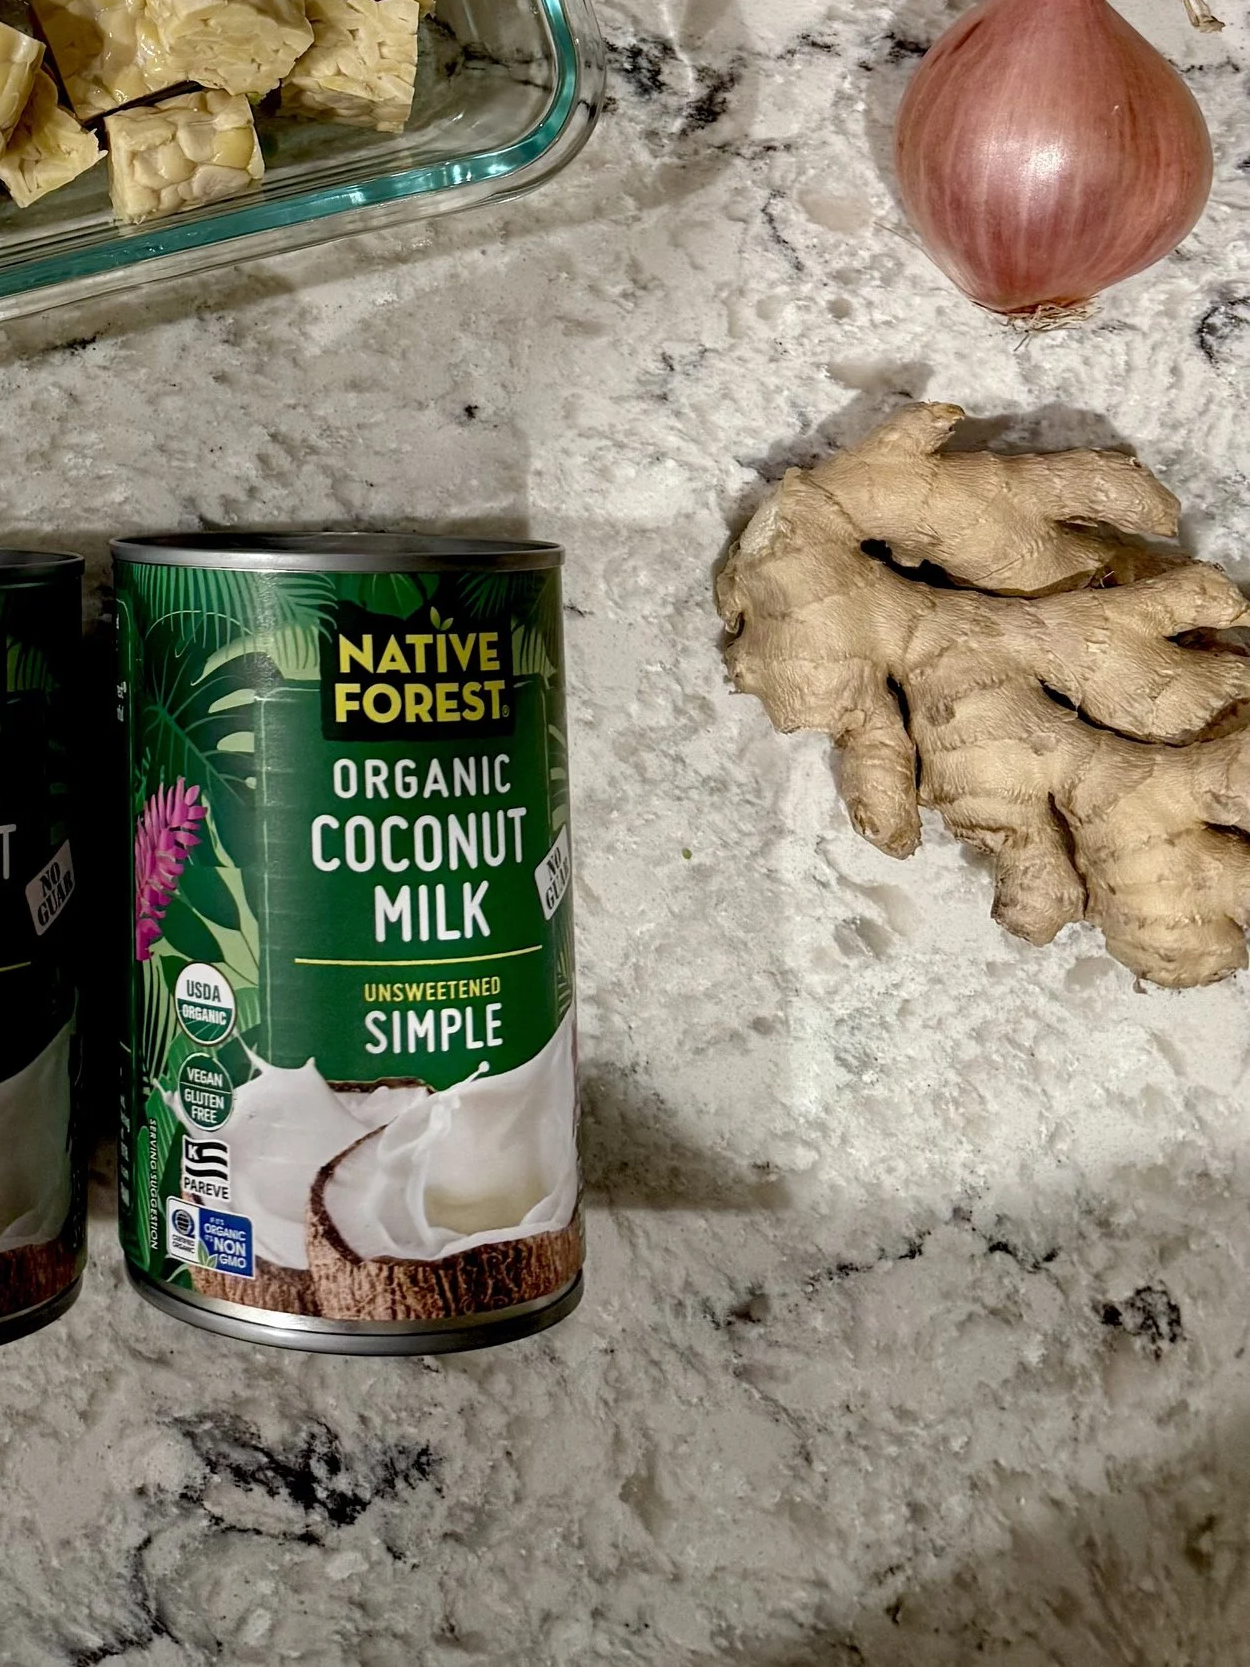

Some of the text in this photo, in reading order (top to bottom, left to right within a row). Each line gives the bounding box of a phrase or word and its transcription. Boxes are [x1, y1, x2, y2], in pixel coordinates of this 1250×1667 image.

[337, 631, 500, 674] NATIVE
[334, 679, 505, 724] FOREST
[332, 753, 512, 799] ORGANIC
[310, 806, 527, 873] COCONUT
[39, 861, 61, 898] NO
[37, 870, 74, 926] GUAR
[373, 880, 491, 943] MILK
[186, 979, 222, 1003] USDA
[363, 976, 502, 1003] UNSWEETENED
[181, 1003, 227, 1026] ORGANIC
[364, 1002, 504, 1056] SIMPLE
[186, 1066, 223, 1088] VEGAN
[183, 1088, 225, 1110] GLUTEN
[191, 1106, 218, 1124] FREE
[187, 1144, 200, 1160] K
[149, 1118, 159, 1250] SERVING SUGGESTION
[183, 1177, 230, 1200] PAREVE
[203, 1223, 247, 1242] ORGANIC
[213, 1238, 247, 1257] NON
[219, 1253, 247, 1269] GMO
